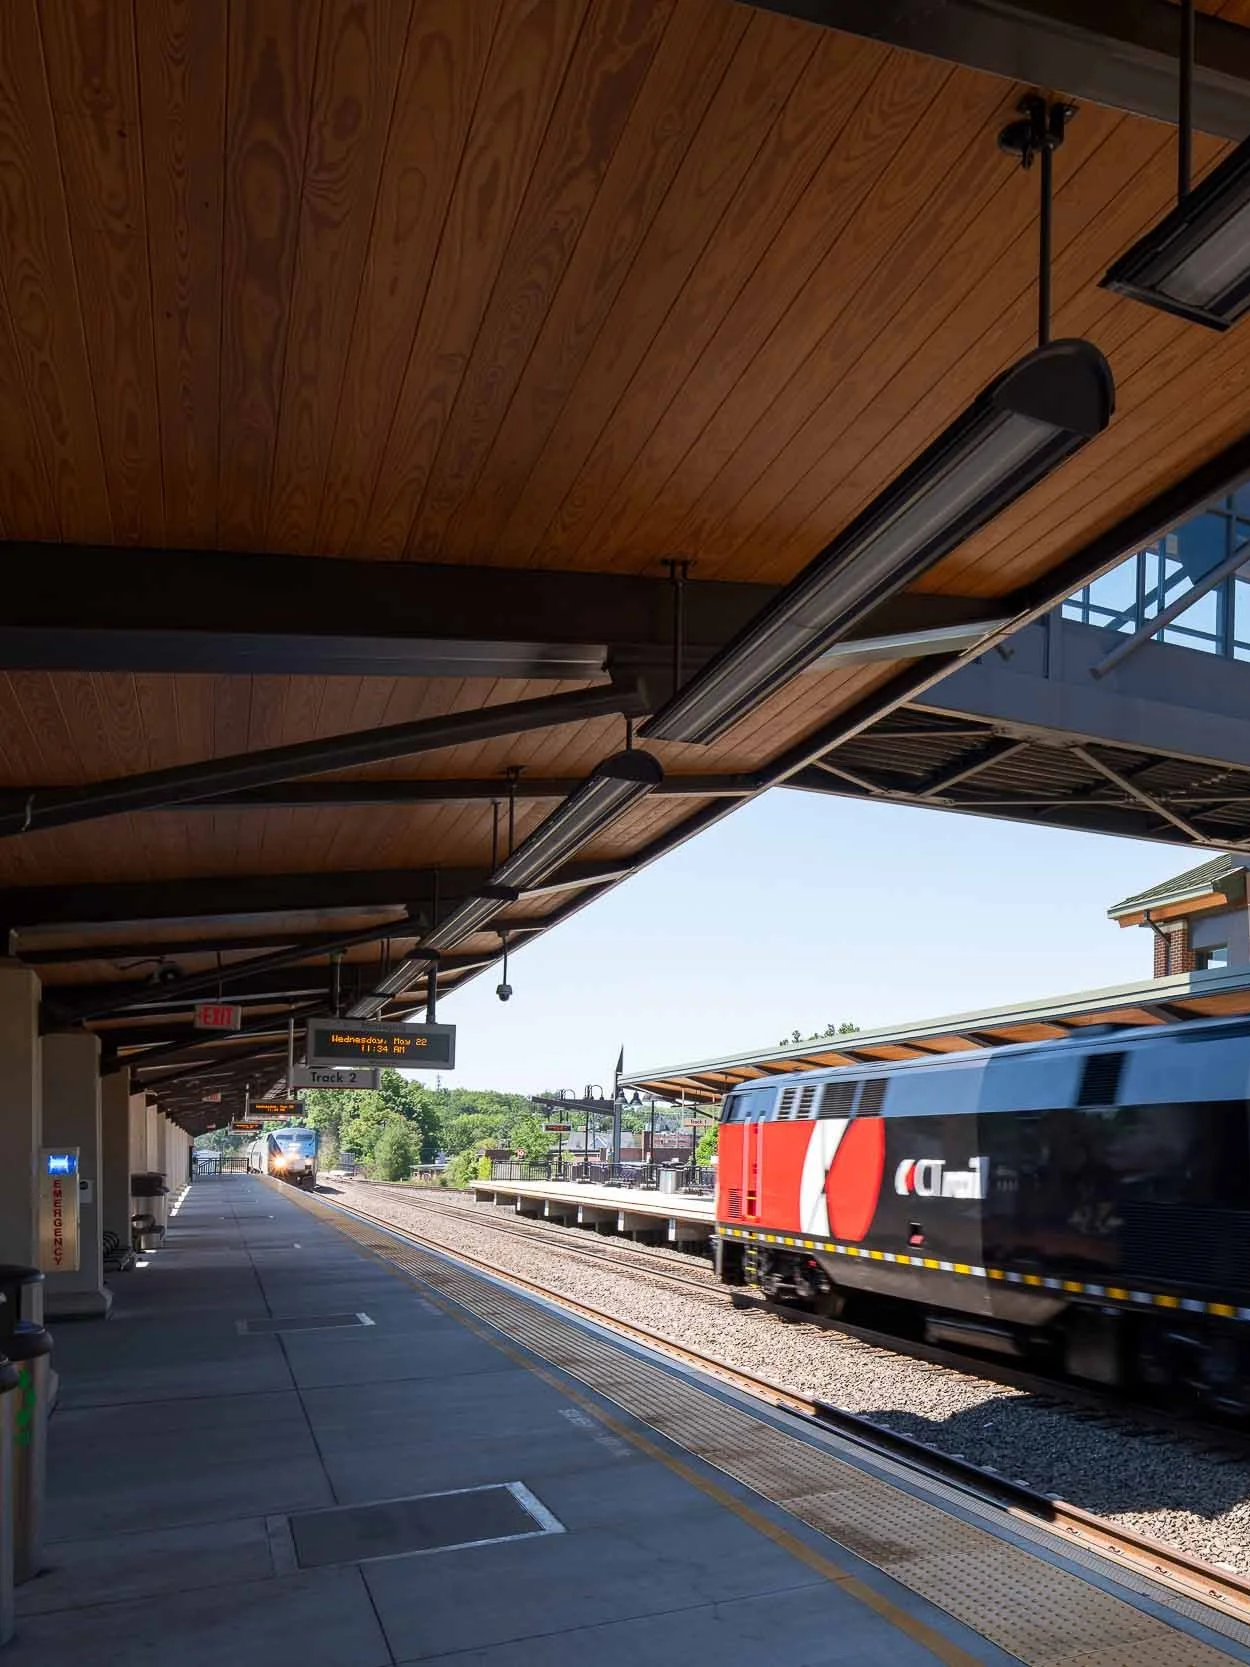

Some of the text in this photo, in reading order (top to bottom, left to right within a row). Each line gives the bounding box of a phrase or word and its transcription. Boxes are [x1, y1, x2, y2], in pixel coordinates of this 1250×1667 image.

[203, 1005, 232, 1026] EXIT
[331, 1034, 428, 1046] Wednesday, May 22
[361, 1045, 405, 1054] 11:34 AM
[311, 1071, 357, 1083] Track 2
[54, 1179, 62, 1265] EMERGENCY
